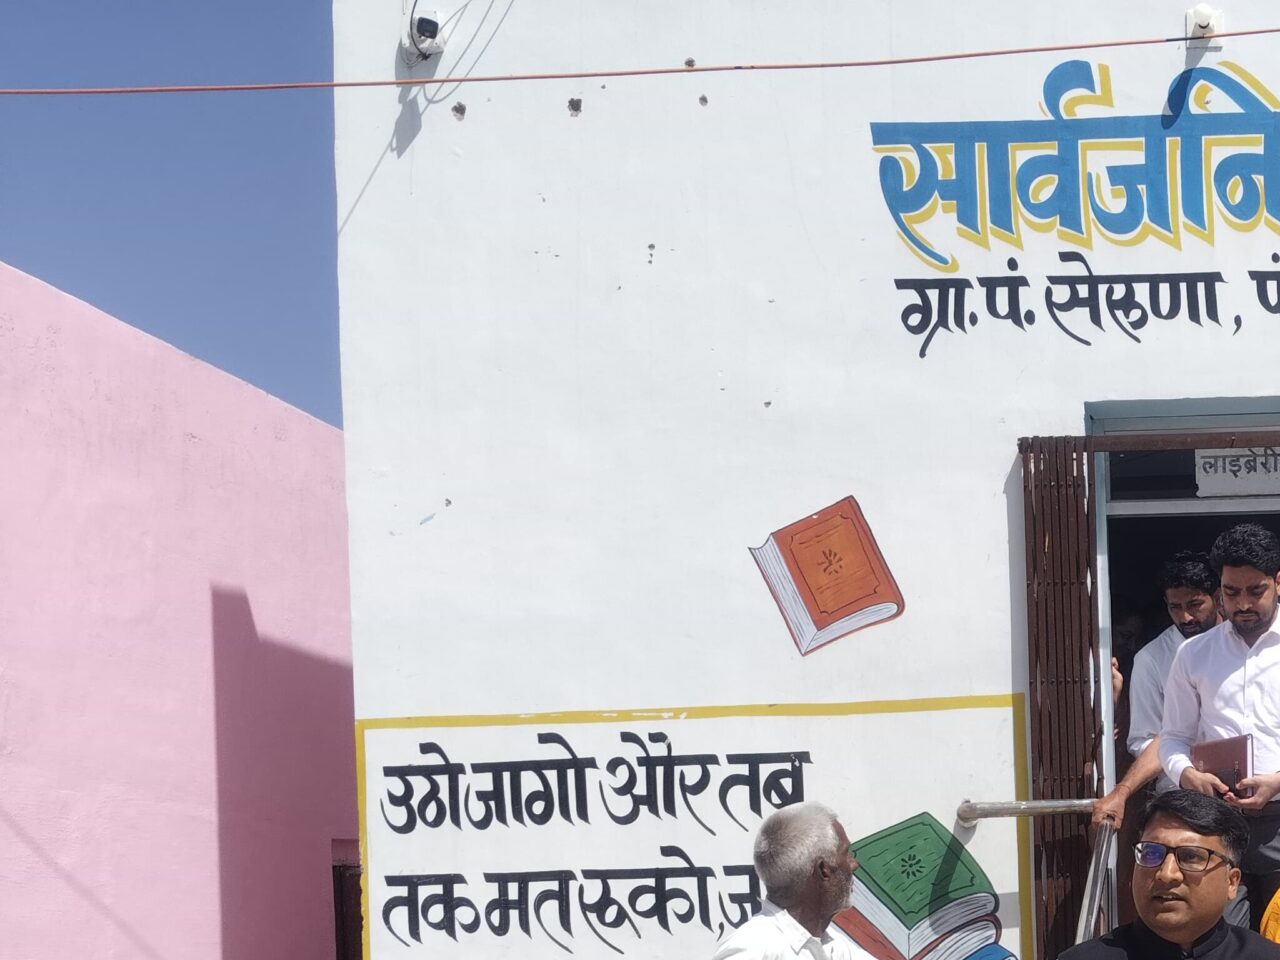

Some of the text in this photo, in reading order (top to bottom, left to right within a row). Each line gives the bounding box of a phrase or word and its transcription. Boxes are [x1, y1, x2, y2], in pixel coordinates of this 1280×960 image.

[1200, 447, 1280, 478] लाइब्रेरी
[380, 732, 813, 836] उठो जागो और तब
[382, 873, 481, 947] तक
[483, 870, 578, 954] मत
